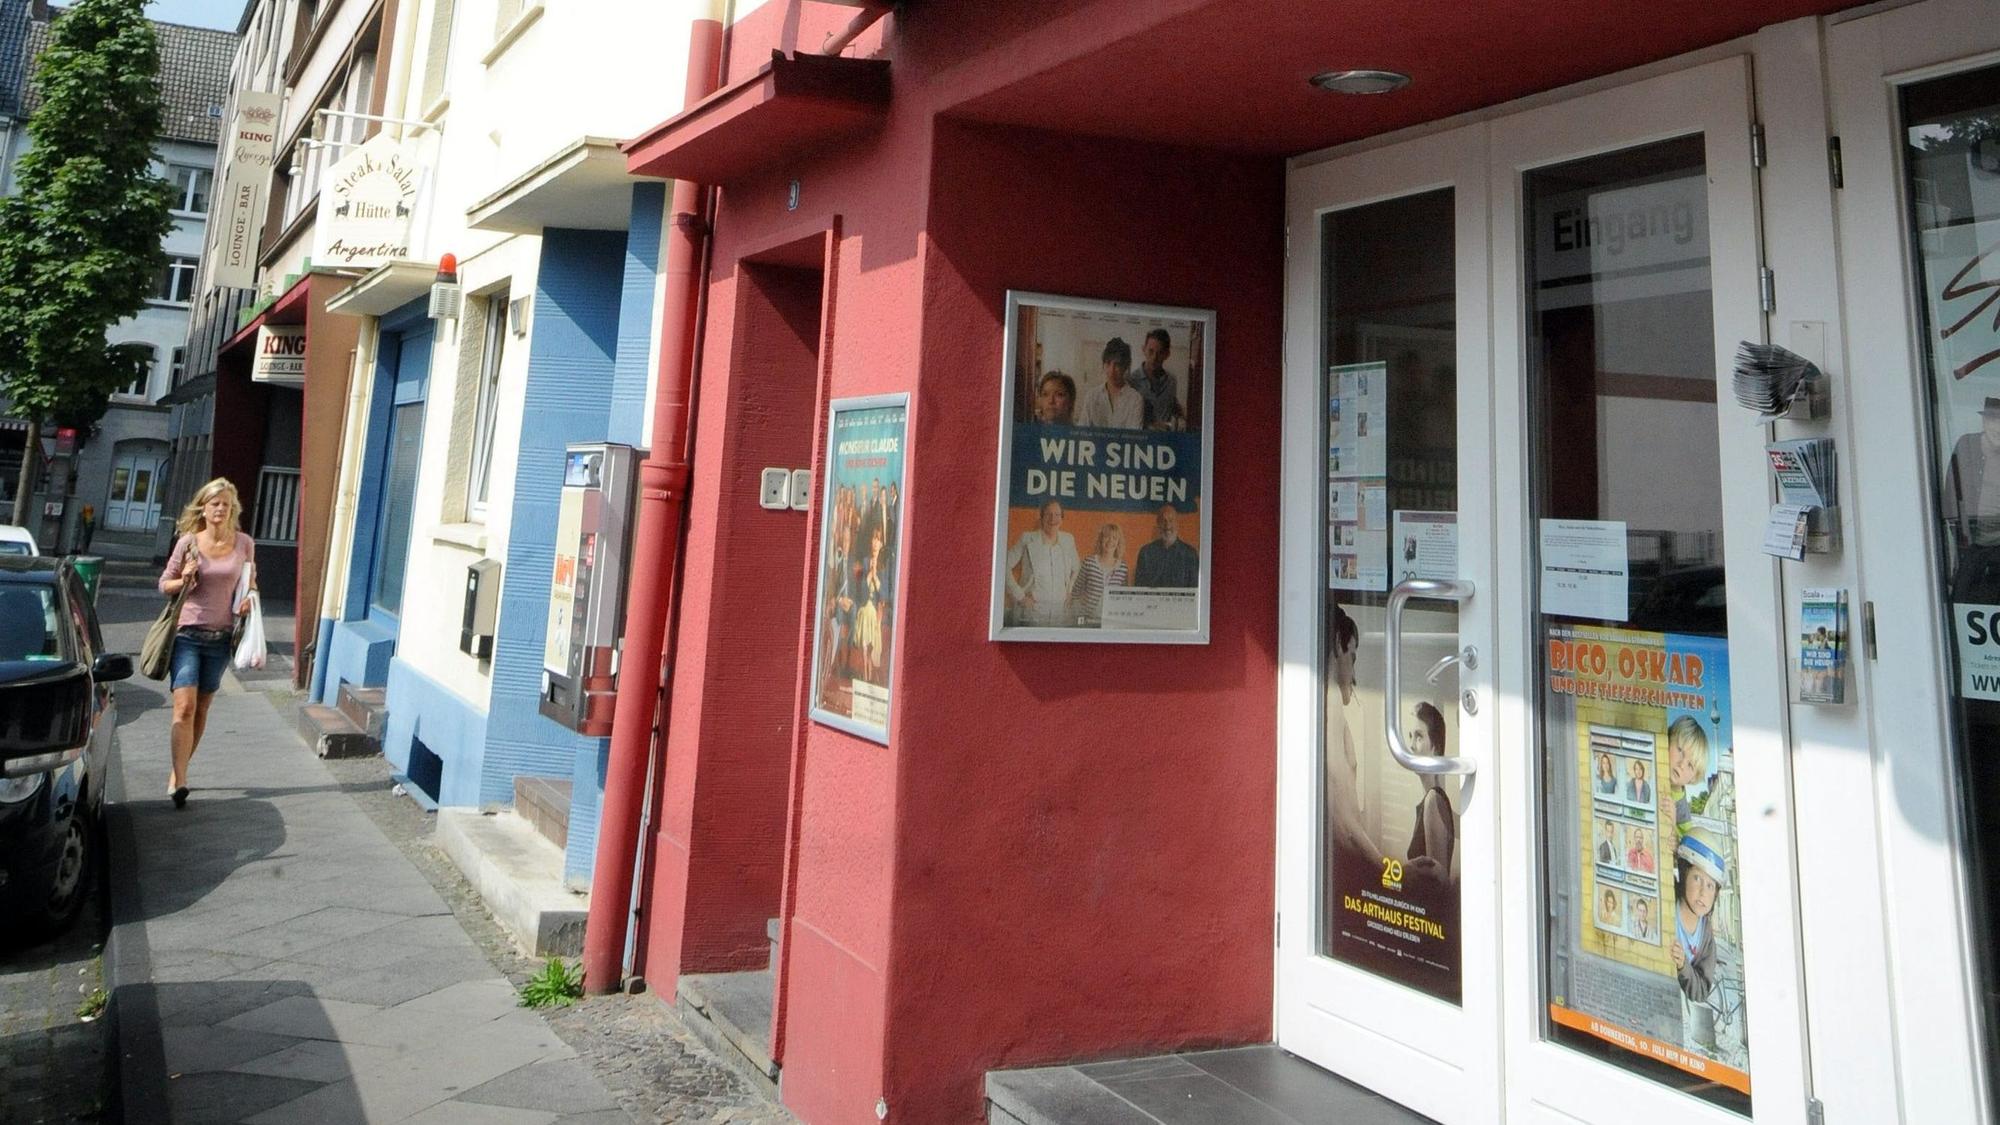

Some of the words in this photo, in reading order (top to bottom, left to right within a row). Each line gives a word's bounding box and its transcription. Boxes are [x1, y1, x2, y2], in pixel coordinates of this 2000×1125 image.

[240, 131, 272, 142] KING
[355, 202, 391, 218] Hütte
[230, 217, 246, 267] LOUNGE
[239, 185, 251, 208] BAR
[1554, 202, 1694, 255] Eingang
[327, 239, 408, 262] Argentina
[263, 336, 305, 355] KING
[871, 438, 898, 453] CLAUDE
[1040, 438, 1096, 466] WIR
[1106, 442, 1176, 471] SIND
[1027, 469, 1076, 497] DIE
[1087, 473, 1187, 503] NEUEN
[1549, 639, 1613, 681] RICO,
[1617, 647, 1705, 688] OSKAR
[1551, 676, 1576, 694] UND
[1576, 679, 1598, 697] DIE
[1382, 857, 1402, 881] 20
[1344, 896, 1361, 913] DAS
[1363, 902, 1402, 926] ARTHAUS
[1403, 914, 1445, 940] FESTIVAL
